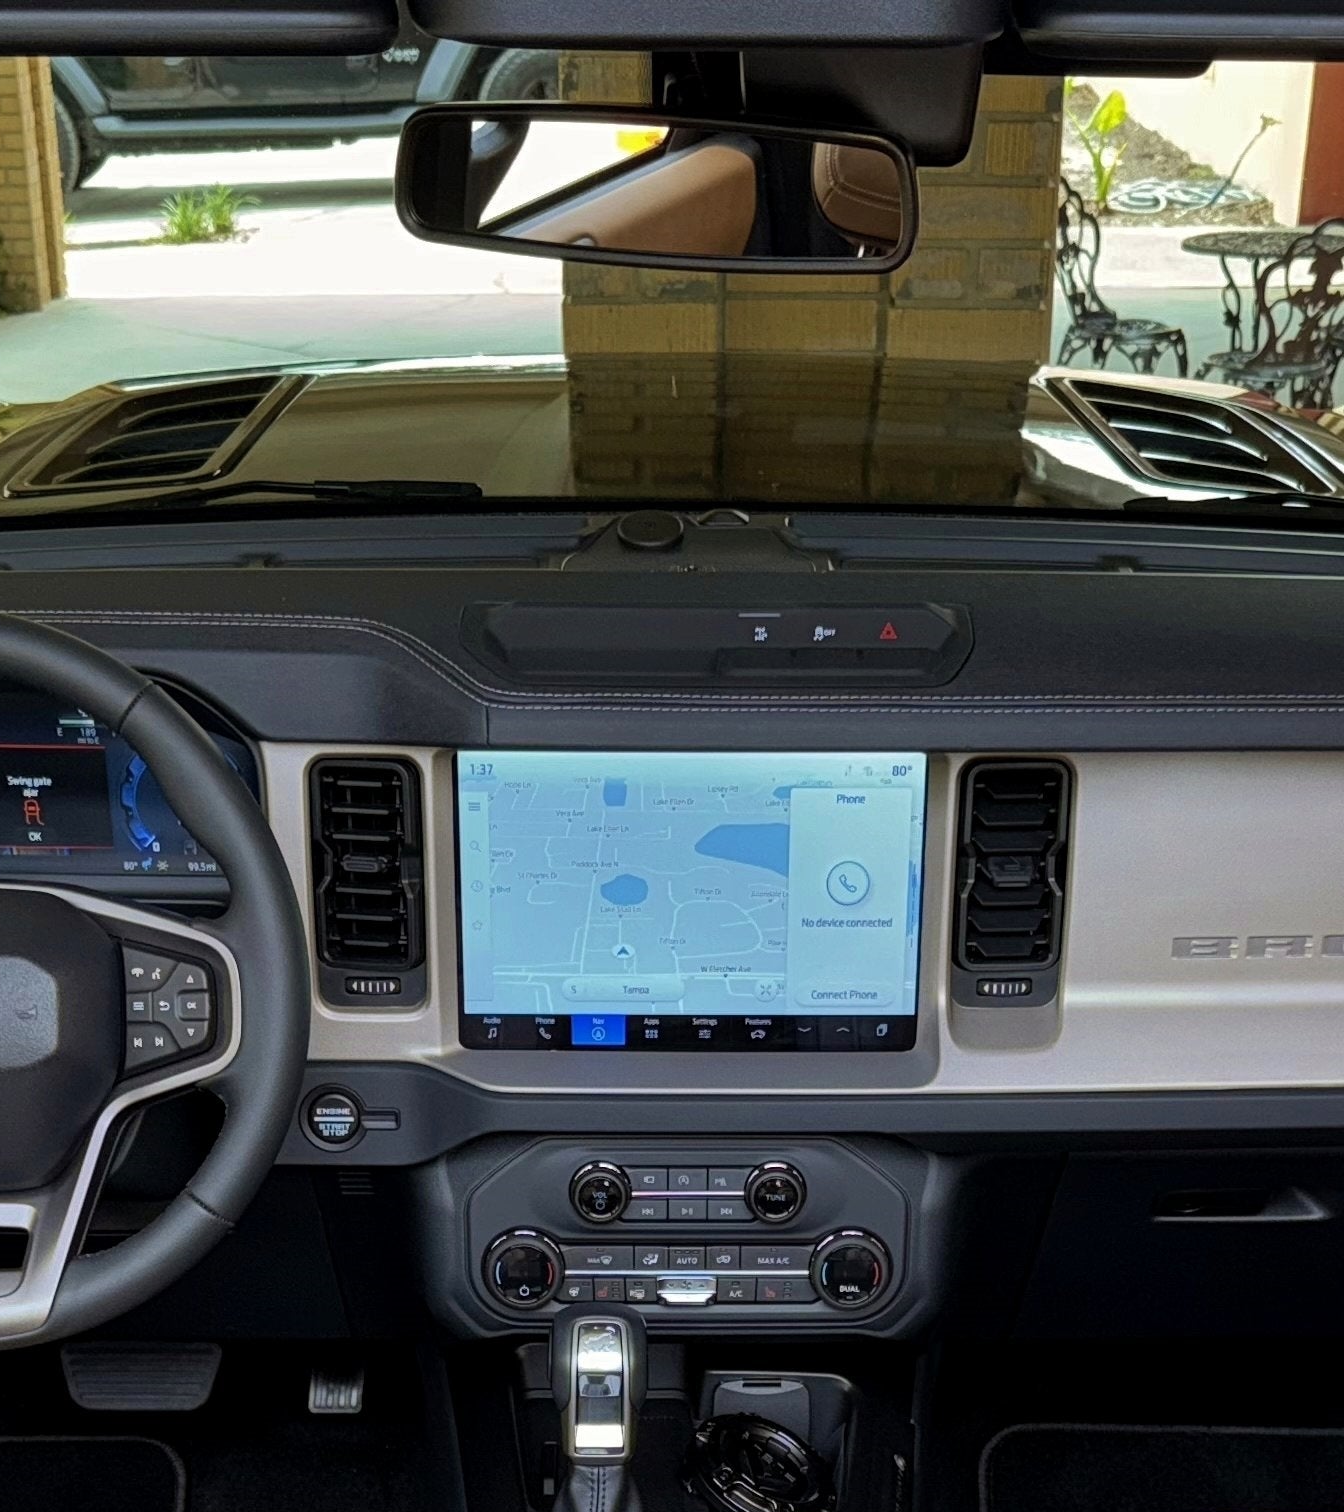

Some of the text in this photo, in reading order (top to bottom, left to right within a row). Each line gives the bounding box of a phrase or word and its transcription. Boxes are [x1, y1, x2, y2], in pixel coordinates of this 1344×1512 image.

[56, 728, 63, 737] E
[469, 763, 494, 776] 1:37
[7, 775, 52, 788] Swing gate
[22, 789, 39, 799] ajar
[836, 794, 866, 804] Phone
[28, 831, 42, 842] OK
[801, 917, 893, 928] No device connected
[709, 965, 737, 973] Fletcher
[737, 965, 752, 973] Ave
[570, 985, 577, 994] S
[622, 986, 650, 995] Tampa
[811, 990, 878, 1000] Connect Phone
[483, 1017, 502, 1025] Audio
[535, 1017, 556, 1025] Phone
[592, 1017, 605, 1025] Nav
[643, 1017, 660, 1026] Apps
[692, 1018, 718, 1027] Settings
[745, 1018, 772, 1026] Features
[316, 1107, 351, 1115] ENGINE
[318, 1123, 350, 1131] START
[592, 1191, 608, 1199] VOL
[766, 1193, 786, 1202] TUNE
[676, 1257, 698, 1265] AUTO
[757, 1257, 790, 1265] MAX A/C
[728, 1290, 743, 1298] A/C
